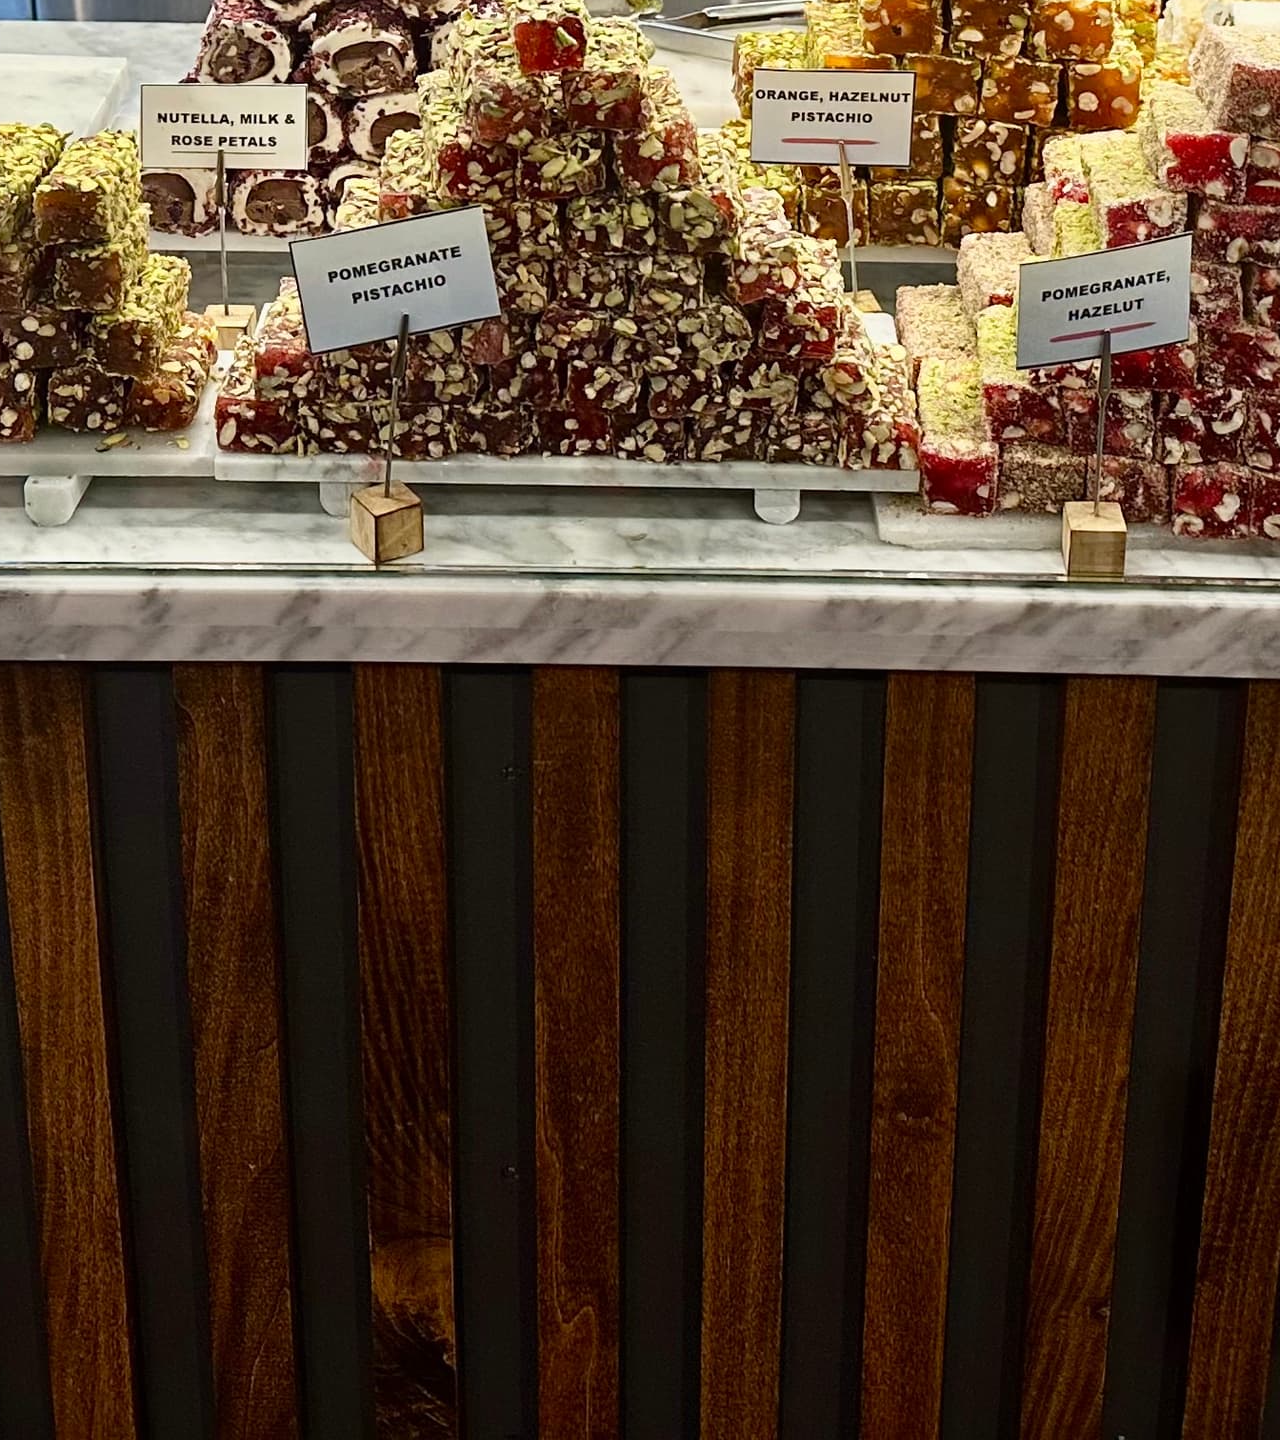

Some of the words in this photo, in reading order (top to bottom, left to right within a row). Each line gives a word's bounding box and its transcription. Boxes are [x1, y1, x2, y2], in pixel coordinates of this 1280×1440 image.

[755, 89, 824, 103] ORANGE,
[829, 91, 911, 103] HAZELNUT
[157, 112, 235, 127] NUTELLA,
[240, 113, 279, 125] MILK
[284, 113, 296, 125] &
[791, 112, 873, 124] PISTACHIO
[171, 135, 213, 147] ROSE
[218, 136, 278, 148] PETALS
[327, 245, 462, 284] POMEGRANATE
[351, 274, 446, 304] PISTACHIO
[1041, 269, 1171, 302] POMEGRANATE,
[1067, 298, 1145, 321] HAZELUT
